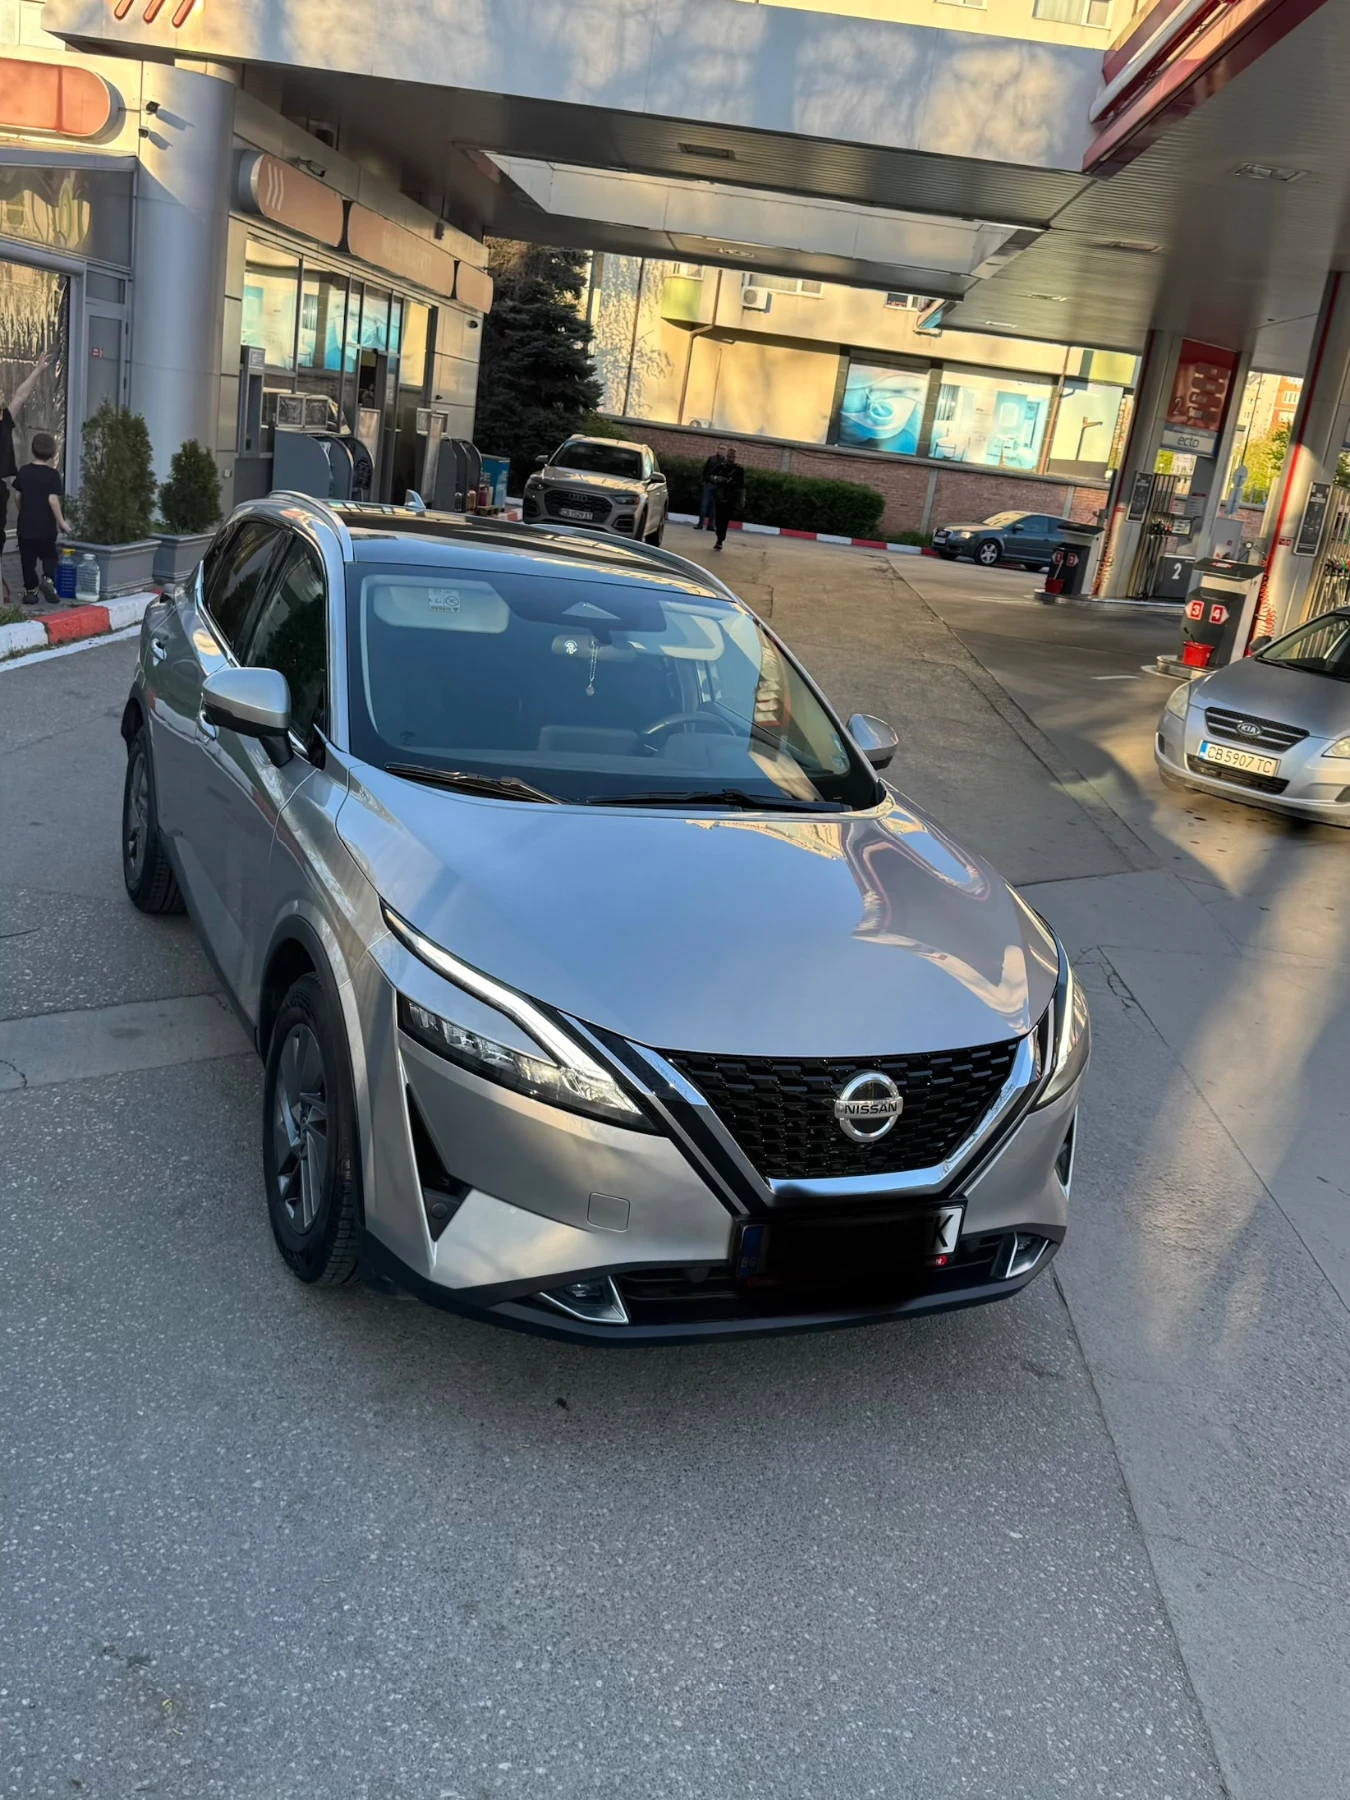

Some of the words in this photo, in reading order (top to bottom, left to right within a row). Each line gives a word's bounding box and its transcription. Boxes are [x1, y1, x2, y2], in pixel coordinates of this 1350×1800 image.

[1177, 436, 1199, 448] ecto
[1171, 563, 1182, 579] 2
[1192, 604, 1201, 616] 3
[1212, 609, 1221, 620] 4
[1241, 724, 1257, 735] KIA
[1207, 746, 1223, 761] CB
[1224, 751, 1255, 768] 5907
[1256, 758, 1273, 774] TC
[844, 1101, 898, 1114] NISSAN
[740, 1256, 757, 1268] BG
